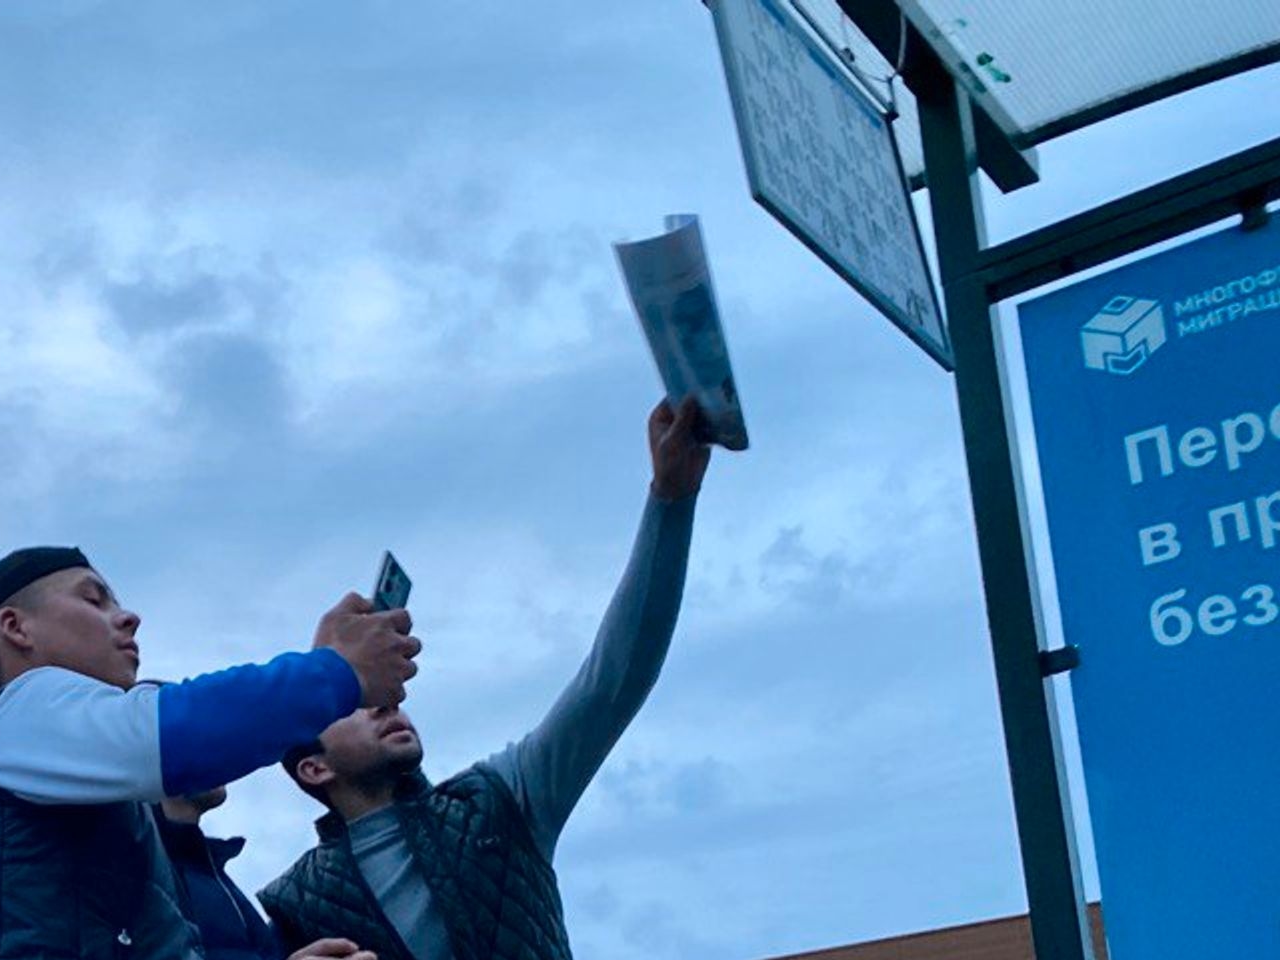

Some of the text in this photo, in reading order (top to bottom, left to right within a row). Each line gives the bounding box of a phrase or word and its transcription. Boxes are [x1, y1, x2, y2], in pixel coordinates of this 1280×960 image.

[1174, 264, 1280, 317] МНОГОФ
[1177, 288, 1280, 337] МИГРАЦ
[1124, 402, 1280, 485] Пер
[1138, 522, 1182, 566] в
[1150, 584, 1280, 646] без
